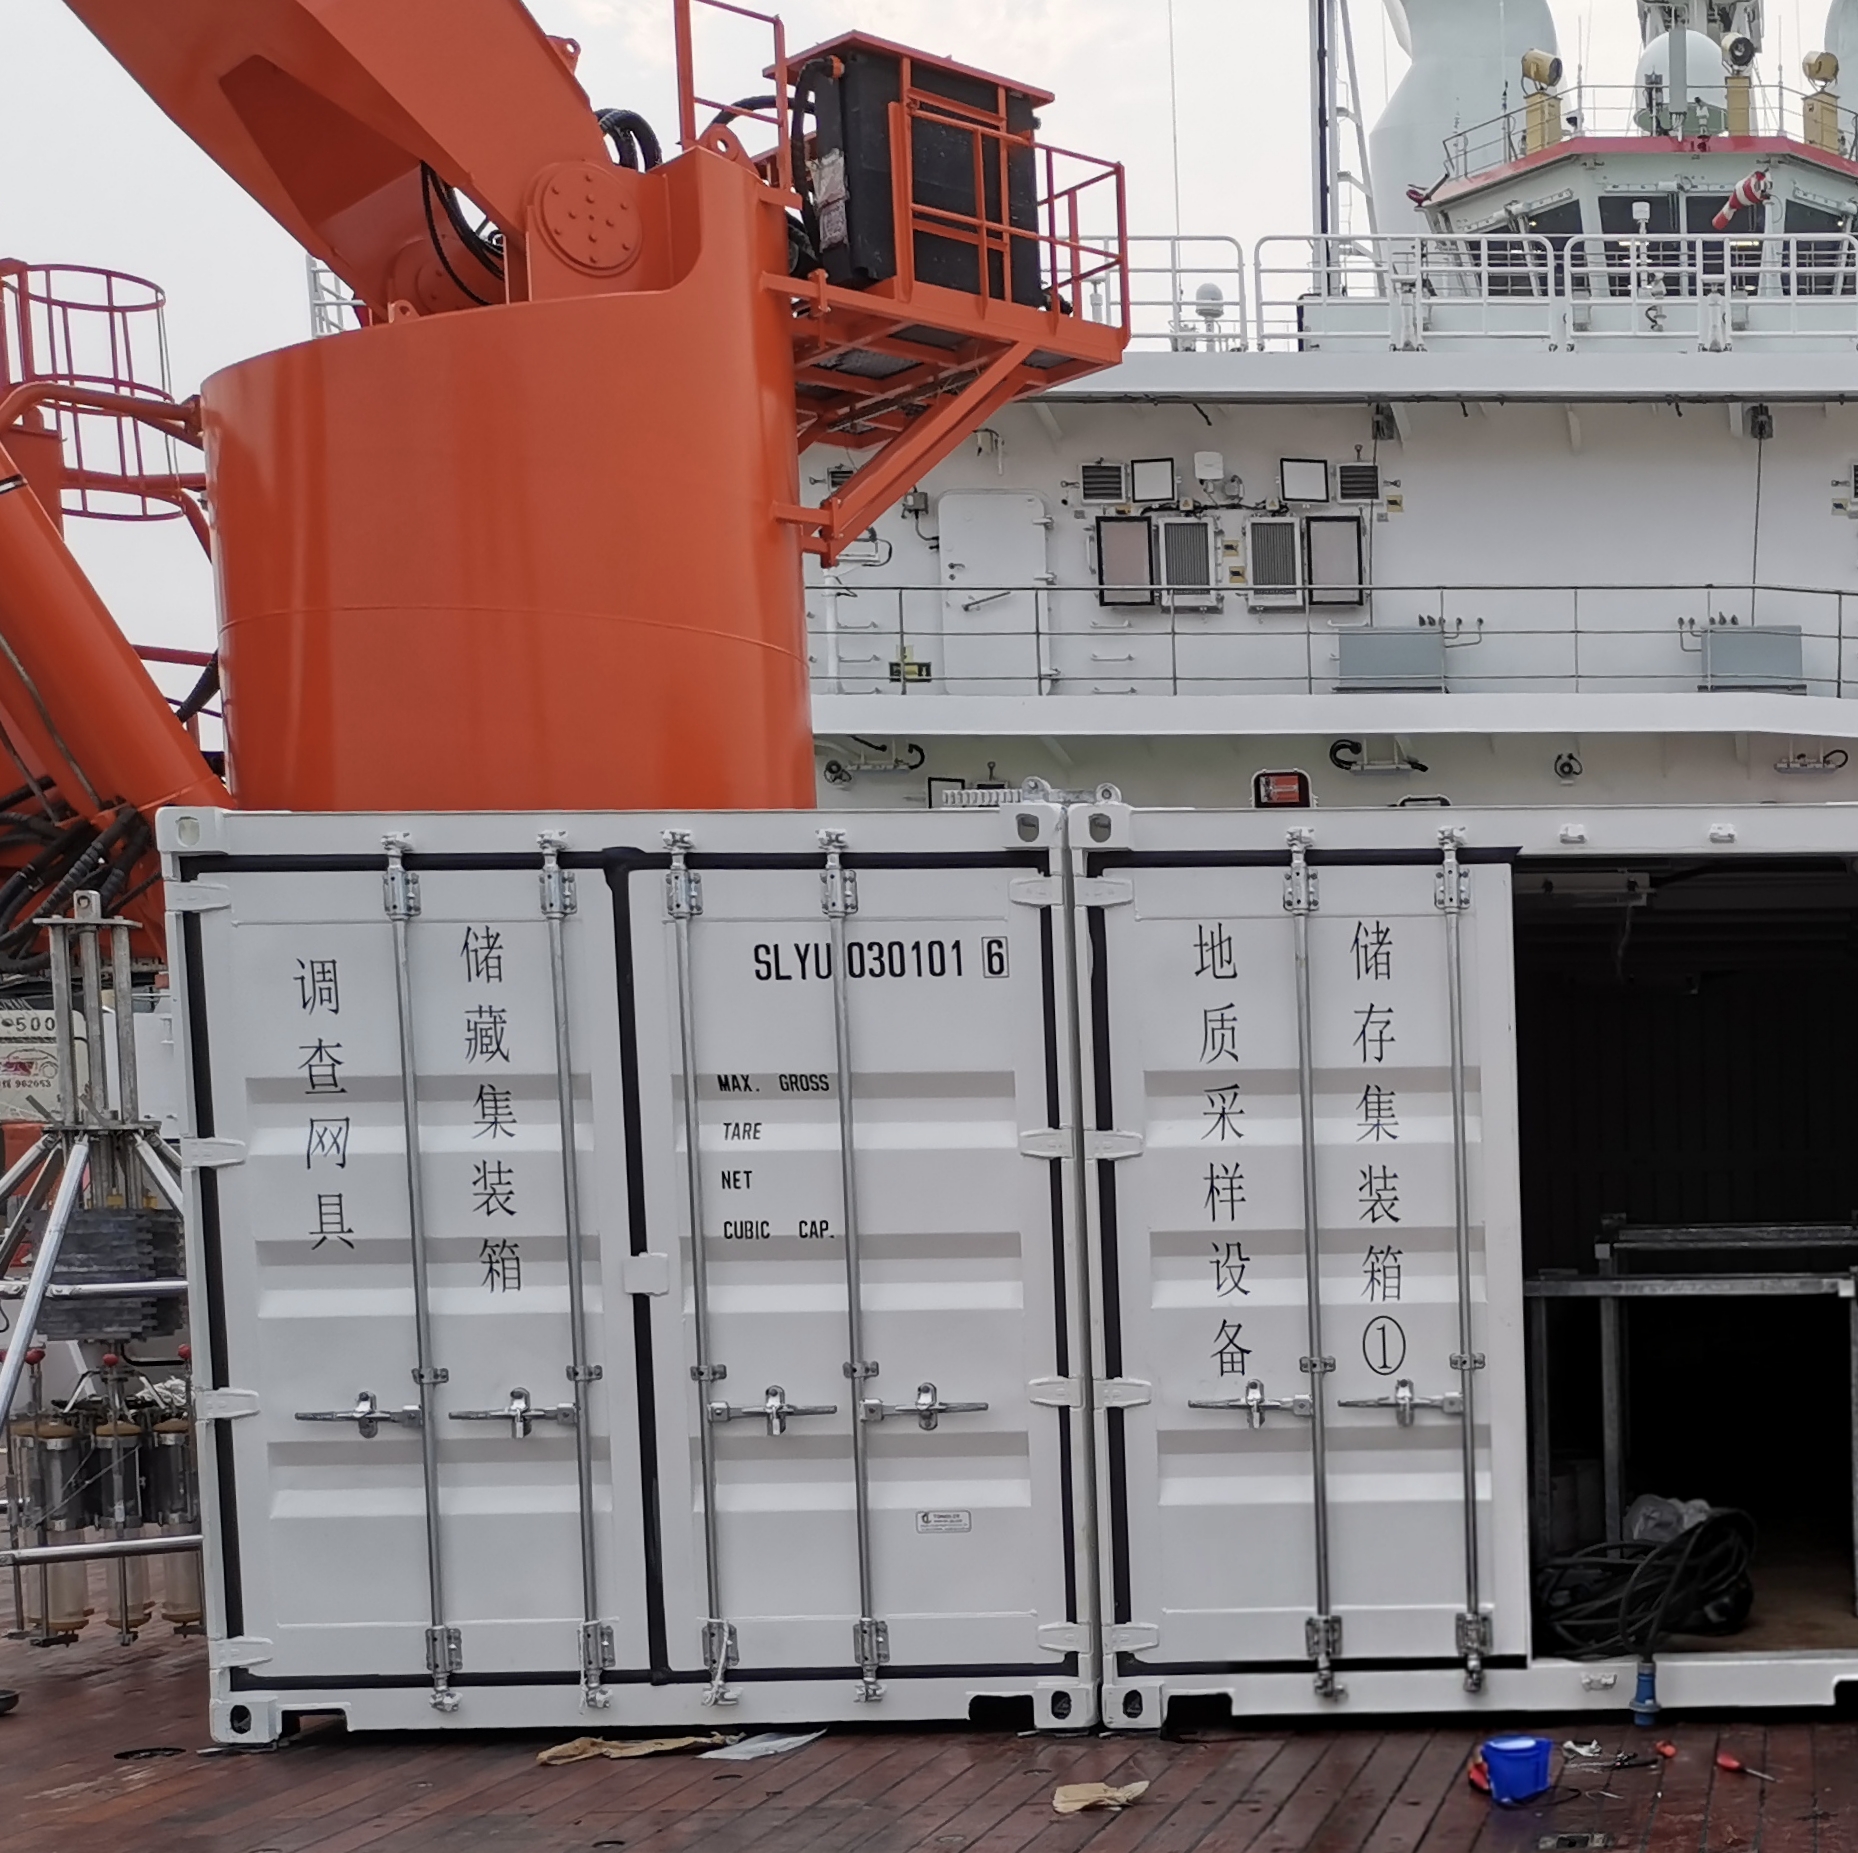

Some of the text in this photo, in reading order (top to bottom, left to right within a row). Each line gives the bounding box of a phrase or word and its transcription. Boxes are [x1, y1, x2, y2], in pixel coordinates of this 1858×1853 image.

[753, 938, 1007, 982] SLYU 030101 6
[717, 1073, 830, 1092] MAX. GROSS
[293, 957, 355, 1251] 调查网具
[460, 925, 522, 1294] 储藏集装箱
[723, 1122, 763, 1141] TARE
[1193, 922, 1253, 1379] 地质采样设备
[721, 1170, 753, 1190] NET
[724, 1219, 835, 1240] CUBIC CAP.
